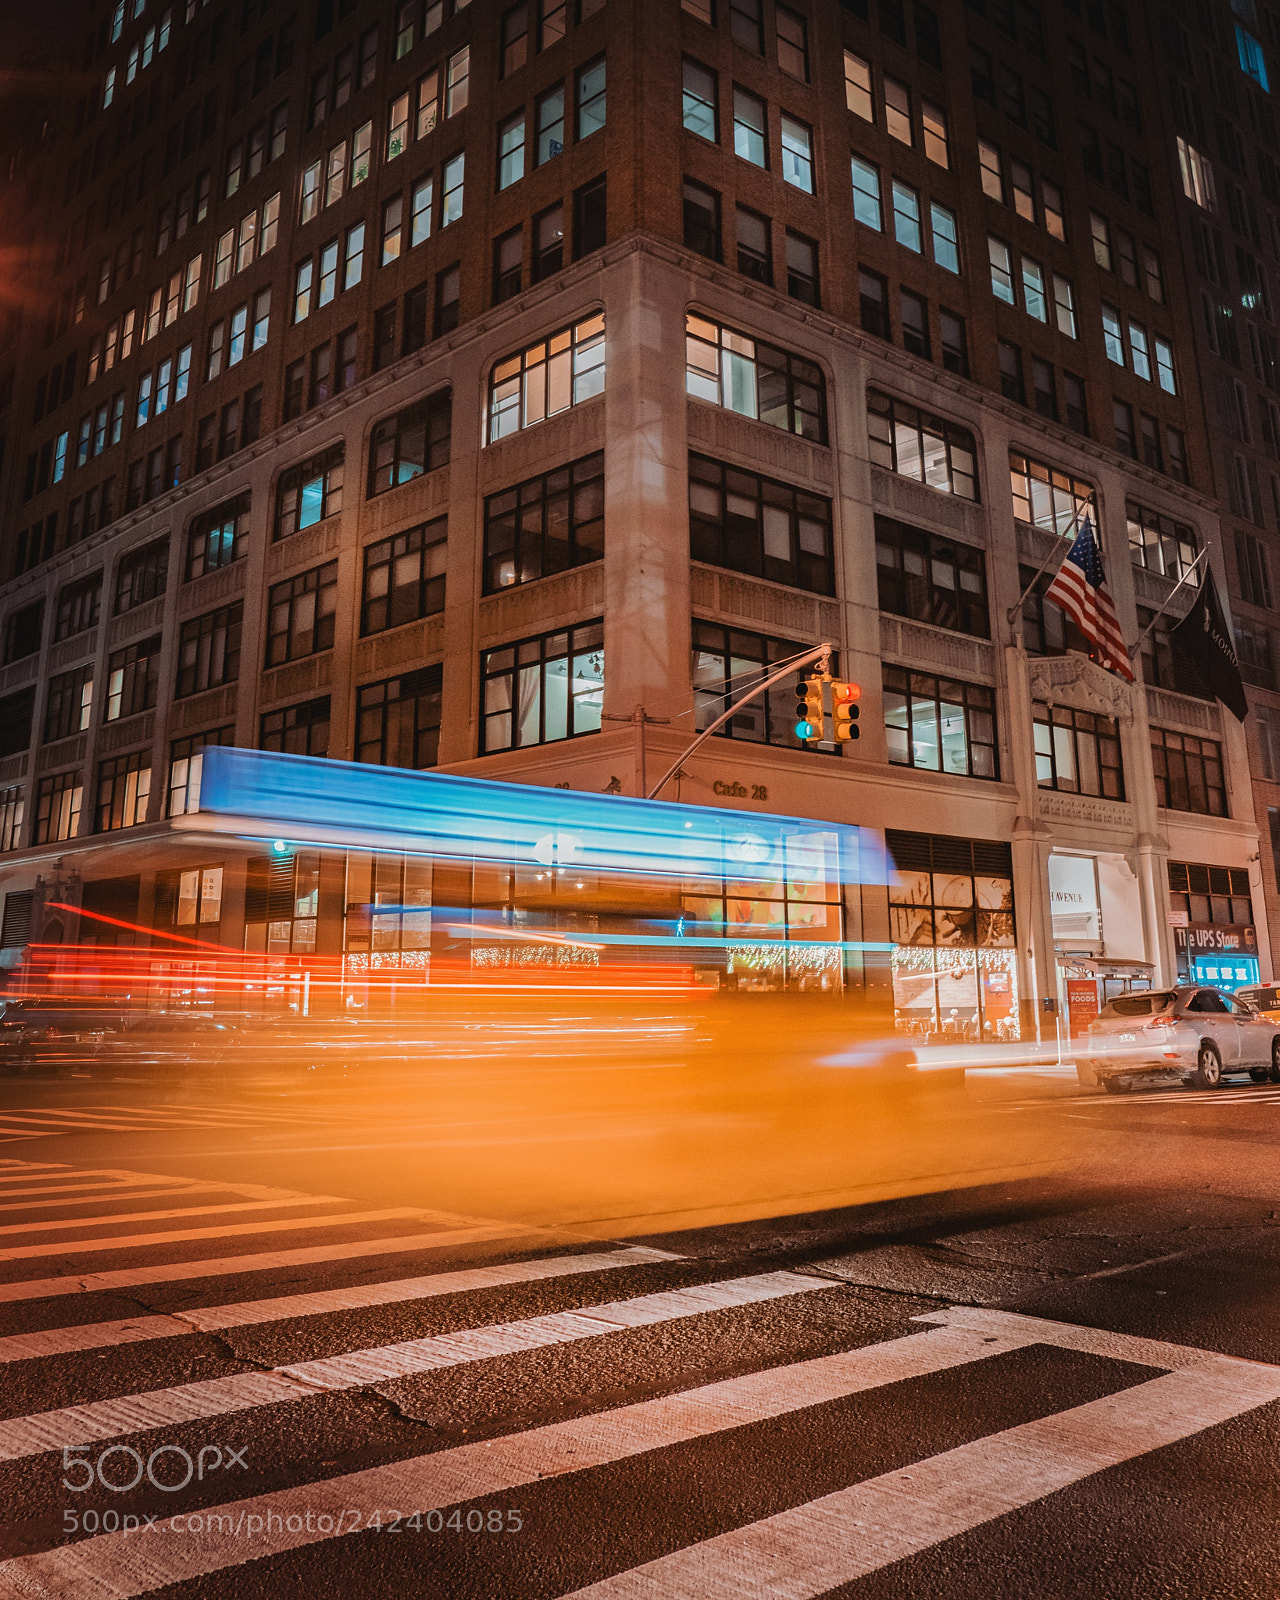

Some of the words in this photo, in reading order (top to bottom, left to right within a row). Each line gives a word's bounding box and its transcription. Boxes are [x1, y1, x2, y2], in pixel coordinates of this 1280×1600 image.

[713, 780, 748, 798] Cafe
[751, 784, 768, 801] 28
[1055, 890, 1083, 903] AVENUE
[1195, 929, 1215, 948] UPS
[1216, 930, 1240, 949] Store
[1071, 995, 1096, 1003] FOODS
